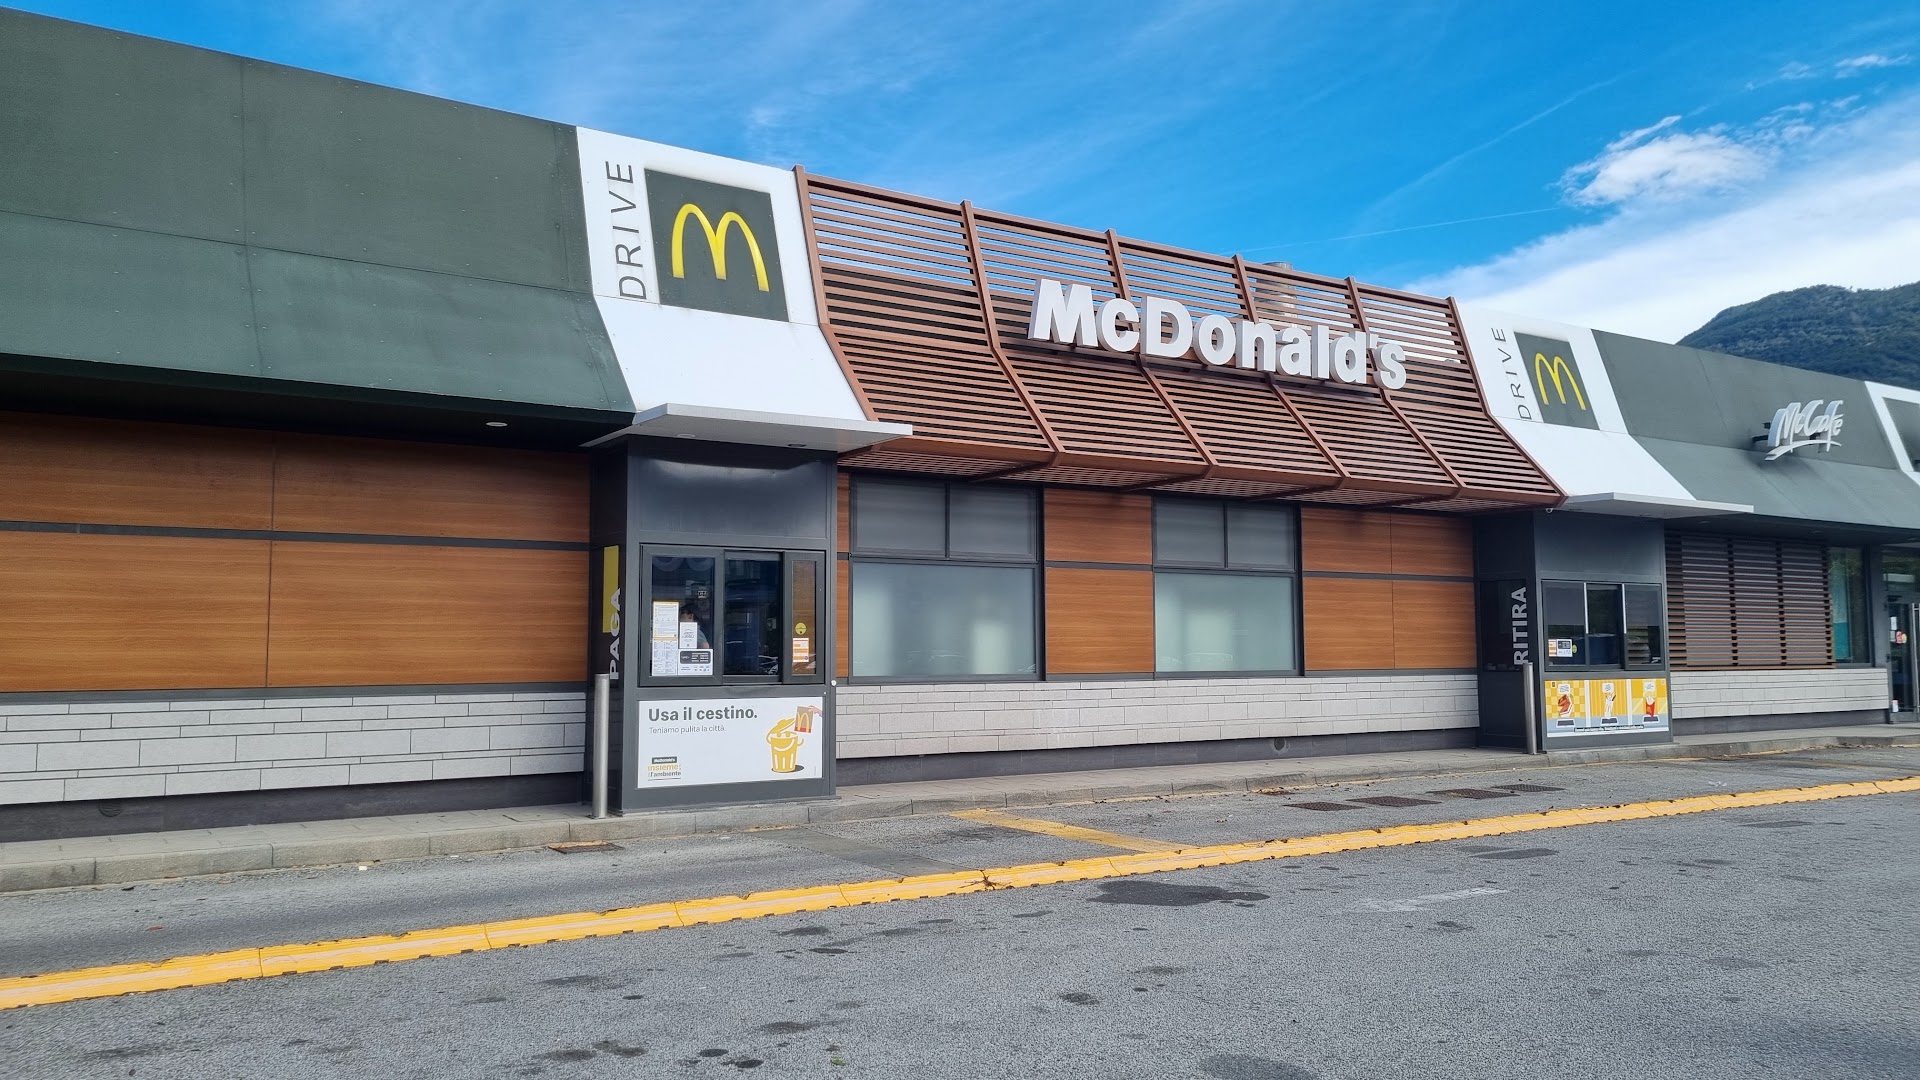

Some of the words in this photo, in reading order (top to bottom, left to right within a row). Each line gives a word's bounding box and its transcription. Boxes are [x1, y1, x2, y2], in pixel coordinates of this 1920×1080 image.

[605, 161, 647, 300] DRIVE
[1028, 278, 1407, 390] McDonald's
[1491, 327, 1532, 420] DRIVE
[609, 587, 620, 679] PAGA
[1511, 586, 1528, 665] RITIRA
[649, 709, 679, 722] Usa
[683, 707, 692, 720] il
[696, 705, 758, 720] cestino.
[649, 726, 679, 734] Teniamo
[680, 725, 700, 735] pulita
